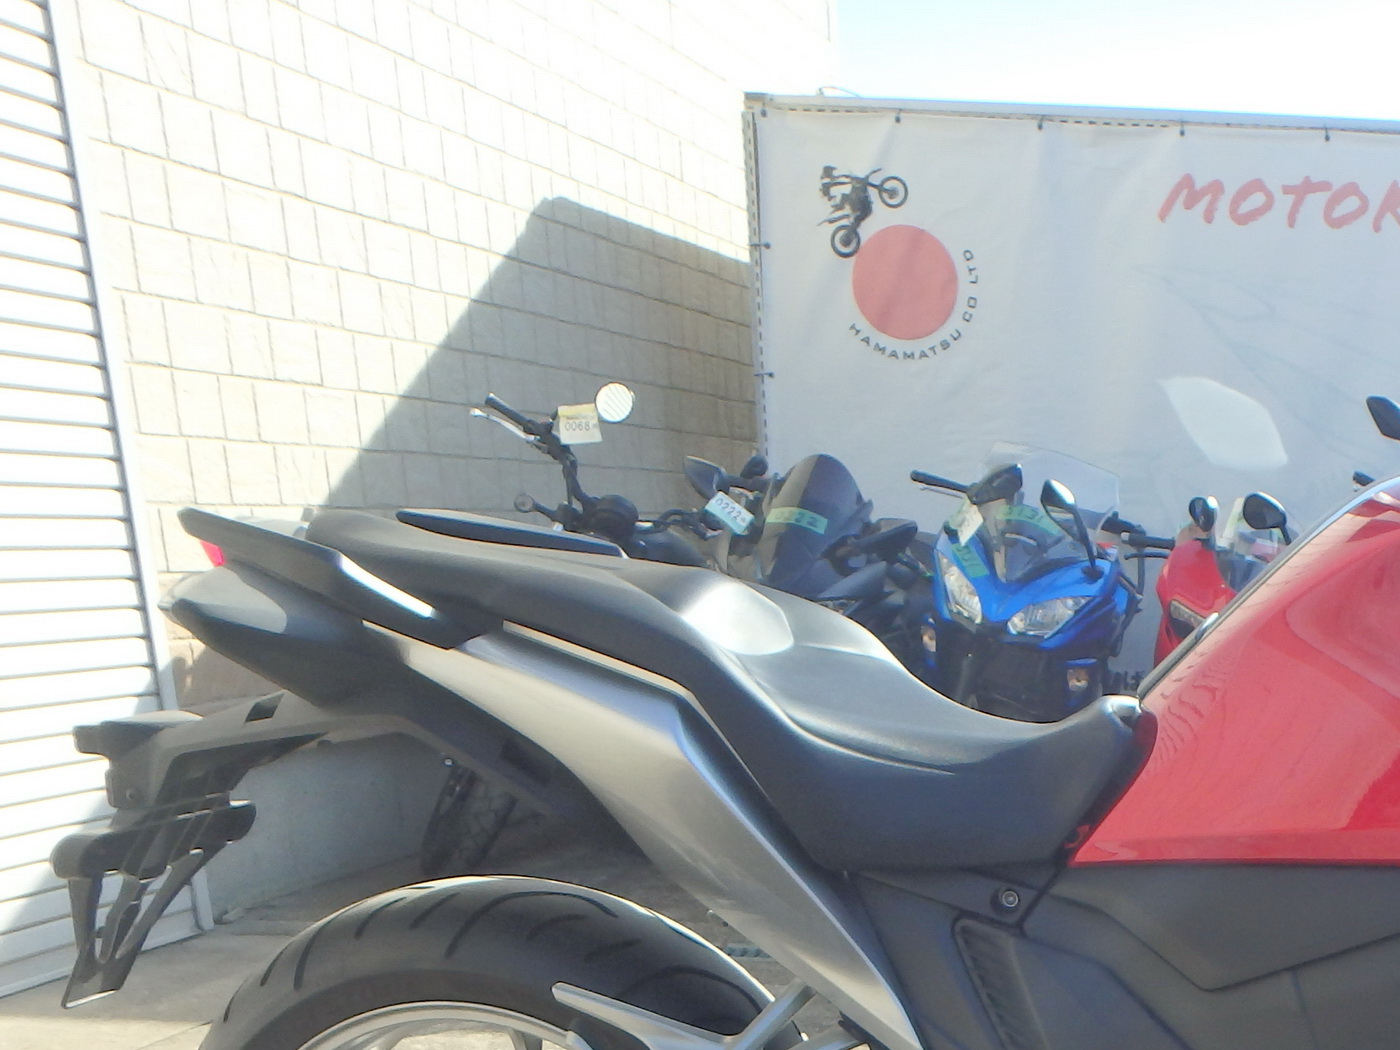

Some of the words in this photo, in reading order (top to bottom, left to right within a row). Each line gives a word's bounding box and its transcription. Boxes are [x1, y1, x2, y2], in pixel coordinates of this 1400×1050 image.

[963, 249, 979, 284] LTD
[962, 296, 977, 323] CO
[849, 323, 962, 360] HAMAMATSU
[564, 421, 592, 432] 0068
[713, 496, 742, 522] 0222
